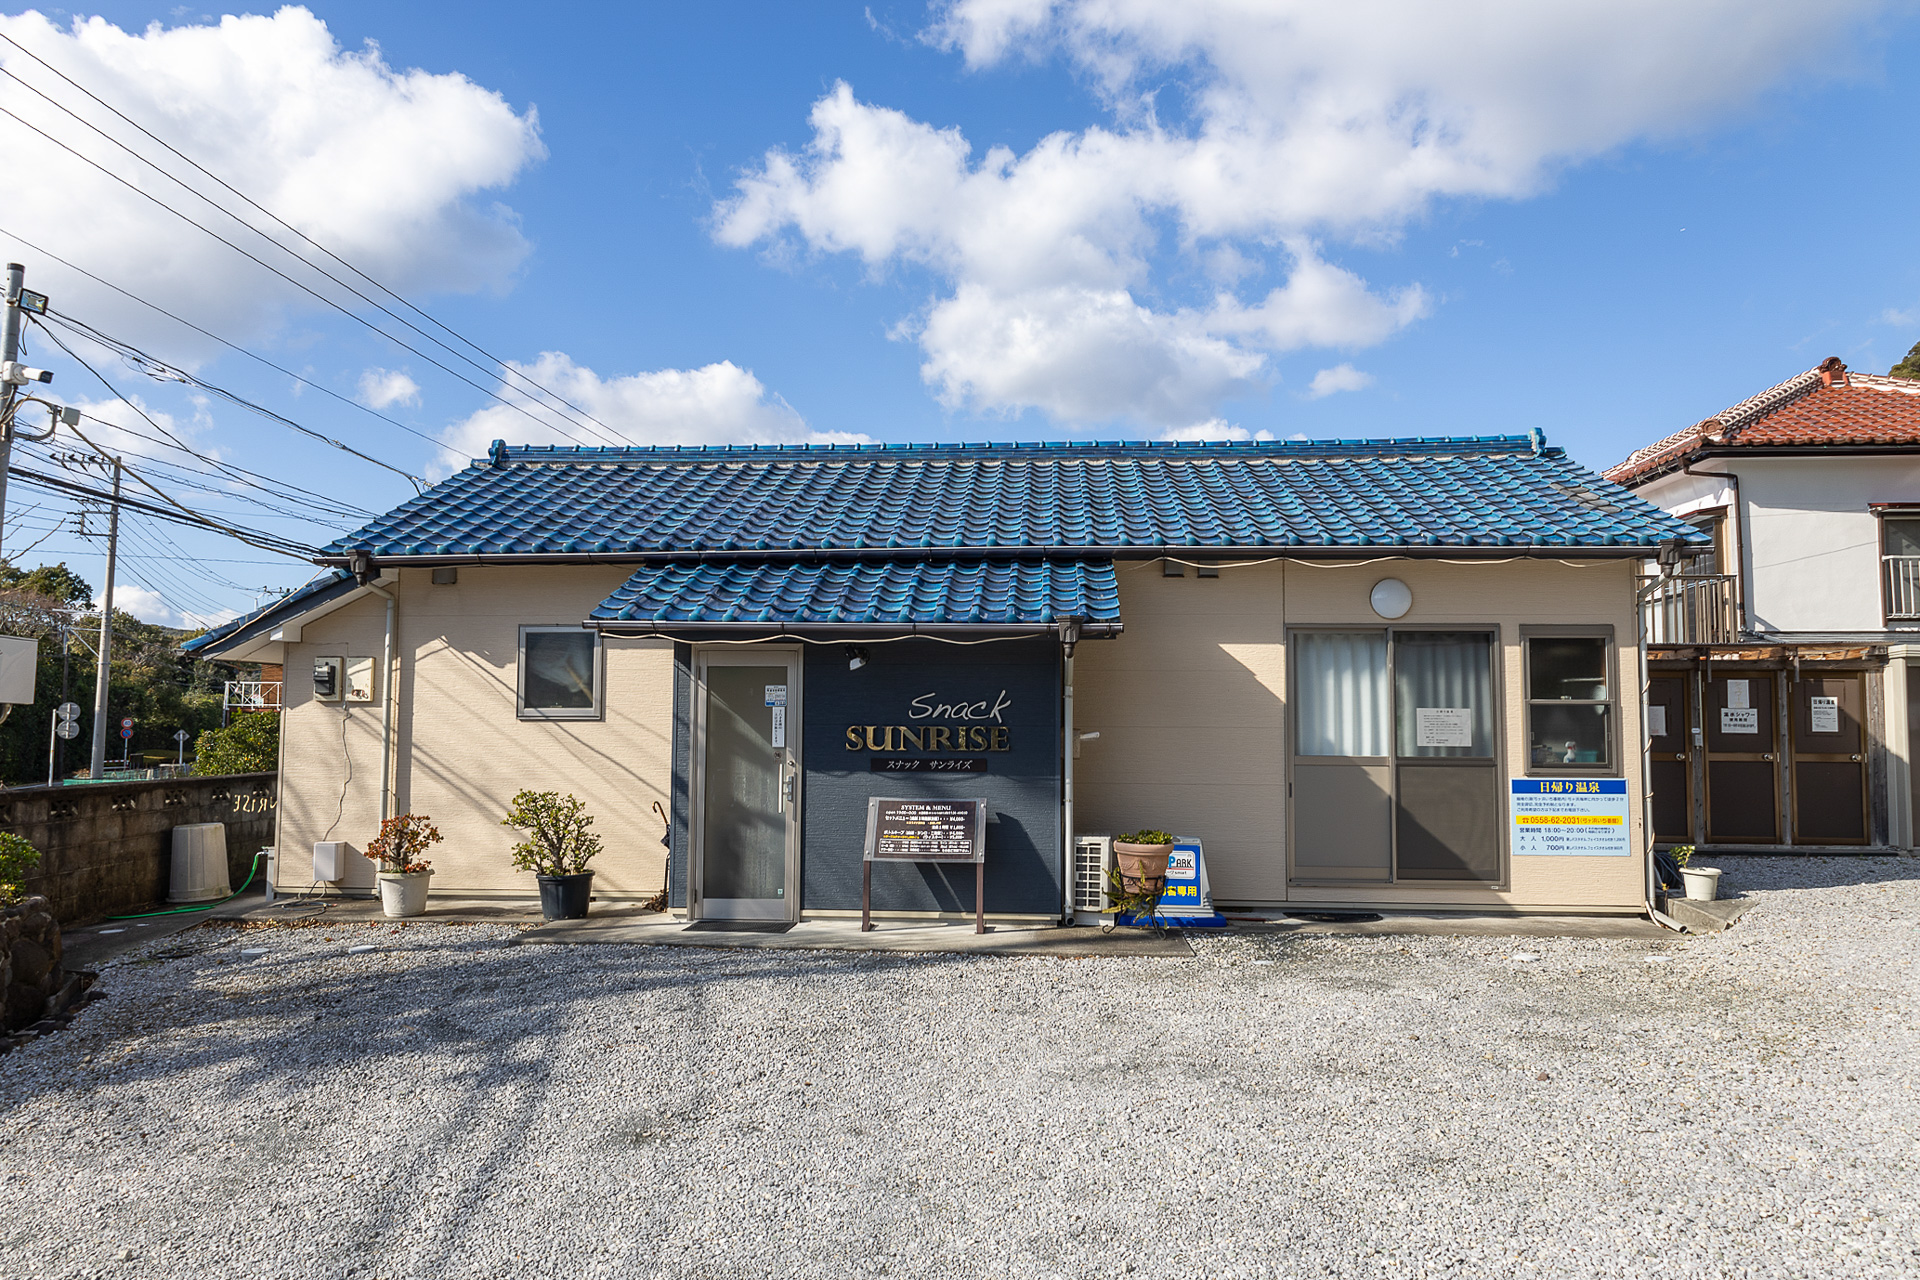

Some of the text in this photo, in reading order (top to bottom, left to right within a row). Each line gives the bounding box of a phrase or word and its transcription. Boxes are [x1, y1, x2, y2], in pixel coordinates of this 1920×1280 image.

[908, 690, 1011, 723] Snack
[845, 726, 1010, 751] SUNRISE
[886, 760, 973, 770] スナック サンライズ
[1540, 781, 1600, 793] 日帰り温泉
[1168, 856, 1192, 869] PARK
